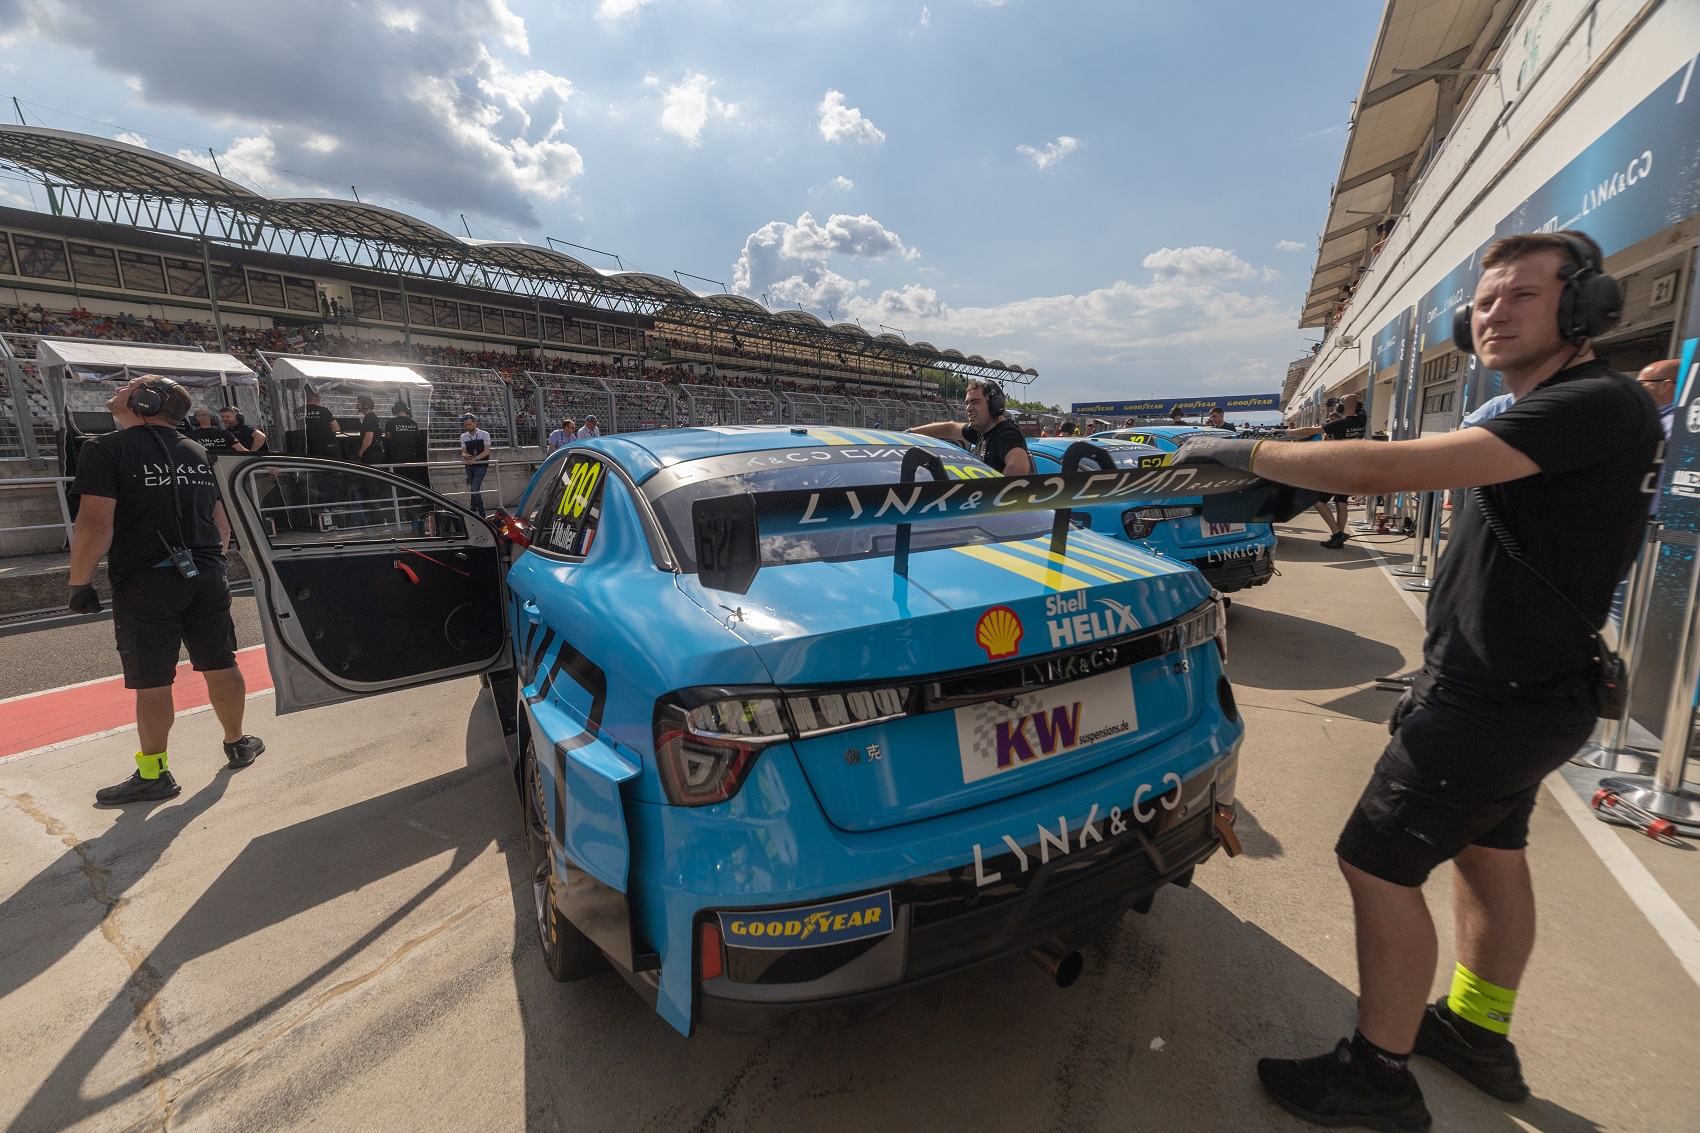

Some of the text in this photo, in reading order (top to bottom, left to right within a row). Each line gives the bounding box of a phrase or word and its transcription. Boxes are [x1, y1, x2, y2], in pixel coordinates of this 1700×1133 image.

[1655, 280, 1671, 301] 21
[1076, 404, 1115, 413] GOODYEAR
[1123, 402, 1164, 411] GOODYEAR
[1226, 397, 1273, 407] GOODYEAR
[557, 462, 601, 518] 100
[1186, 477, 1261, 491] RACING
[1209, 522, 1231, 536] KW
[1045, 589, 1087, 617] Shell
[1046, 603, 1143, 648] HELIX
[994, 700, 1130, 769] KW suspensions.de
[730, 906, 882, 941] GOODYEAR
